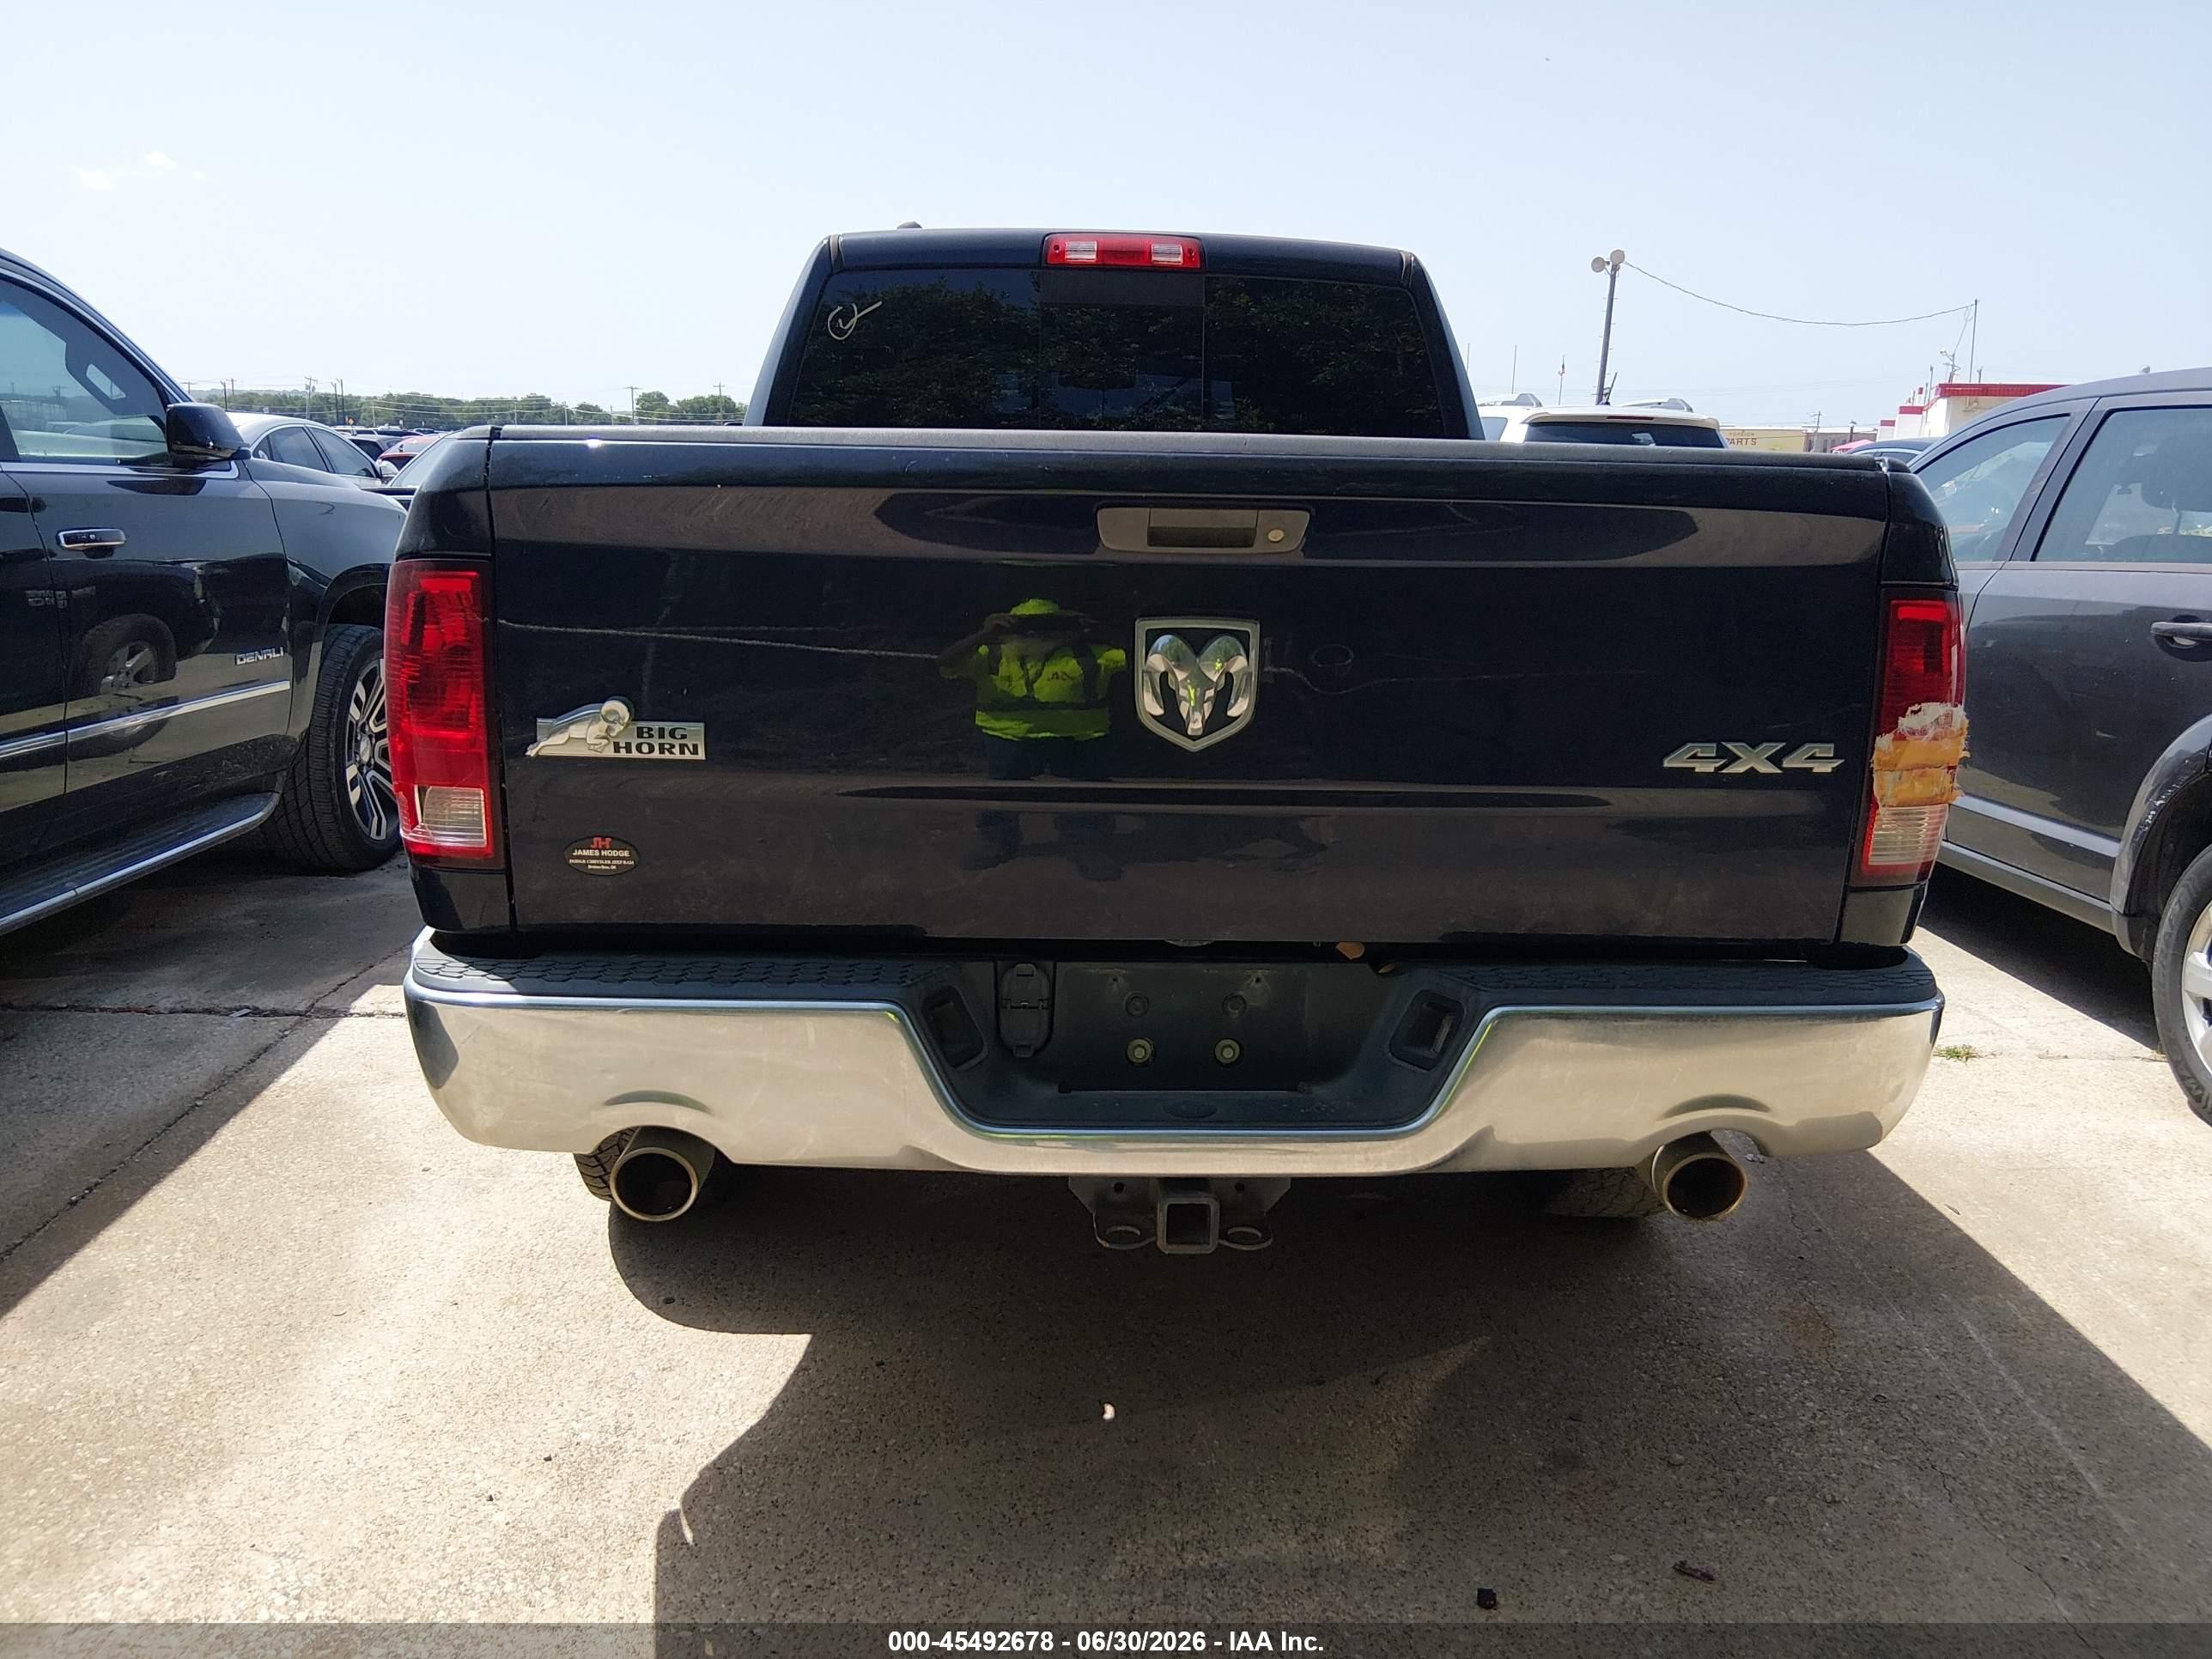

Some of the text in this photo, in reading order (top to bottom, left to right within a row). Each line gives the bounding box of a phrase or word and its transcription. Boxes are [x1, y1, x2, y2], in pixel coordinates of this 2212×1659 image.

[235, 646, 284, 665] DENALI
[636, 726, 688, 740] BIG
[612, 741, 700, 756] HORN
